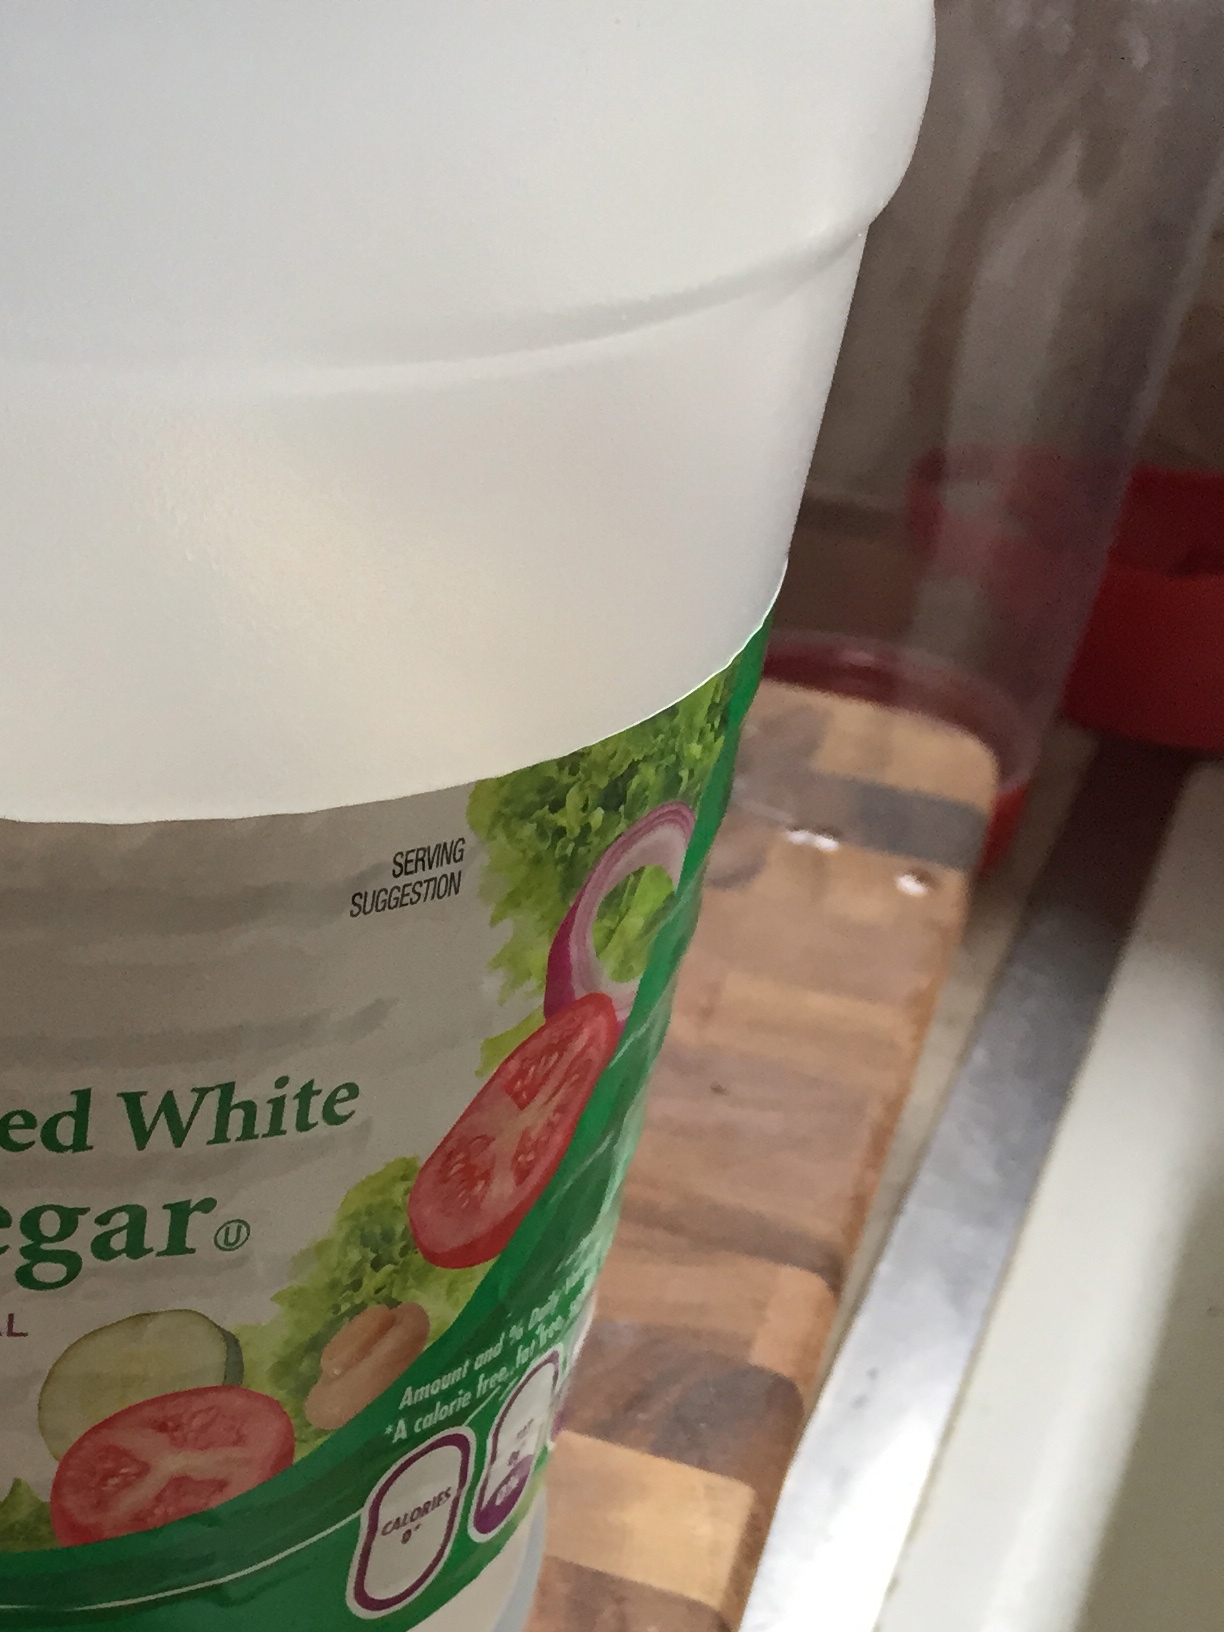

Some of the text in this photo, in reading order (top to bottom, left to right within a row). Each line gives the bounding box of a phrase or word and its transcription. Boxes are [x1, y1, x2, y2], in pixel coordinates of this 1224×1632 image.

[392, 837, 466, 878] SERVING
[349, 871, 462, 918] SUGGESTION
[117, 1075, 360, 1152] White
[398, 1358, 470, 1410] Amount
[474, 1332, 505, 1371] and
[413, 1389, 472, 1433] calorie
[381, 1486, 452, 1536] CALORIES
